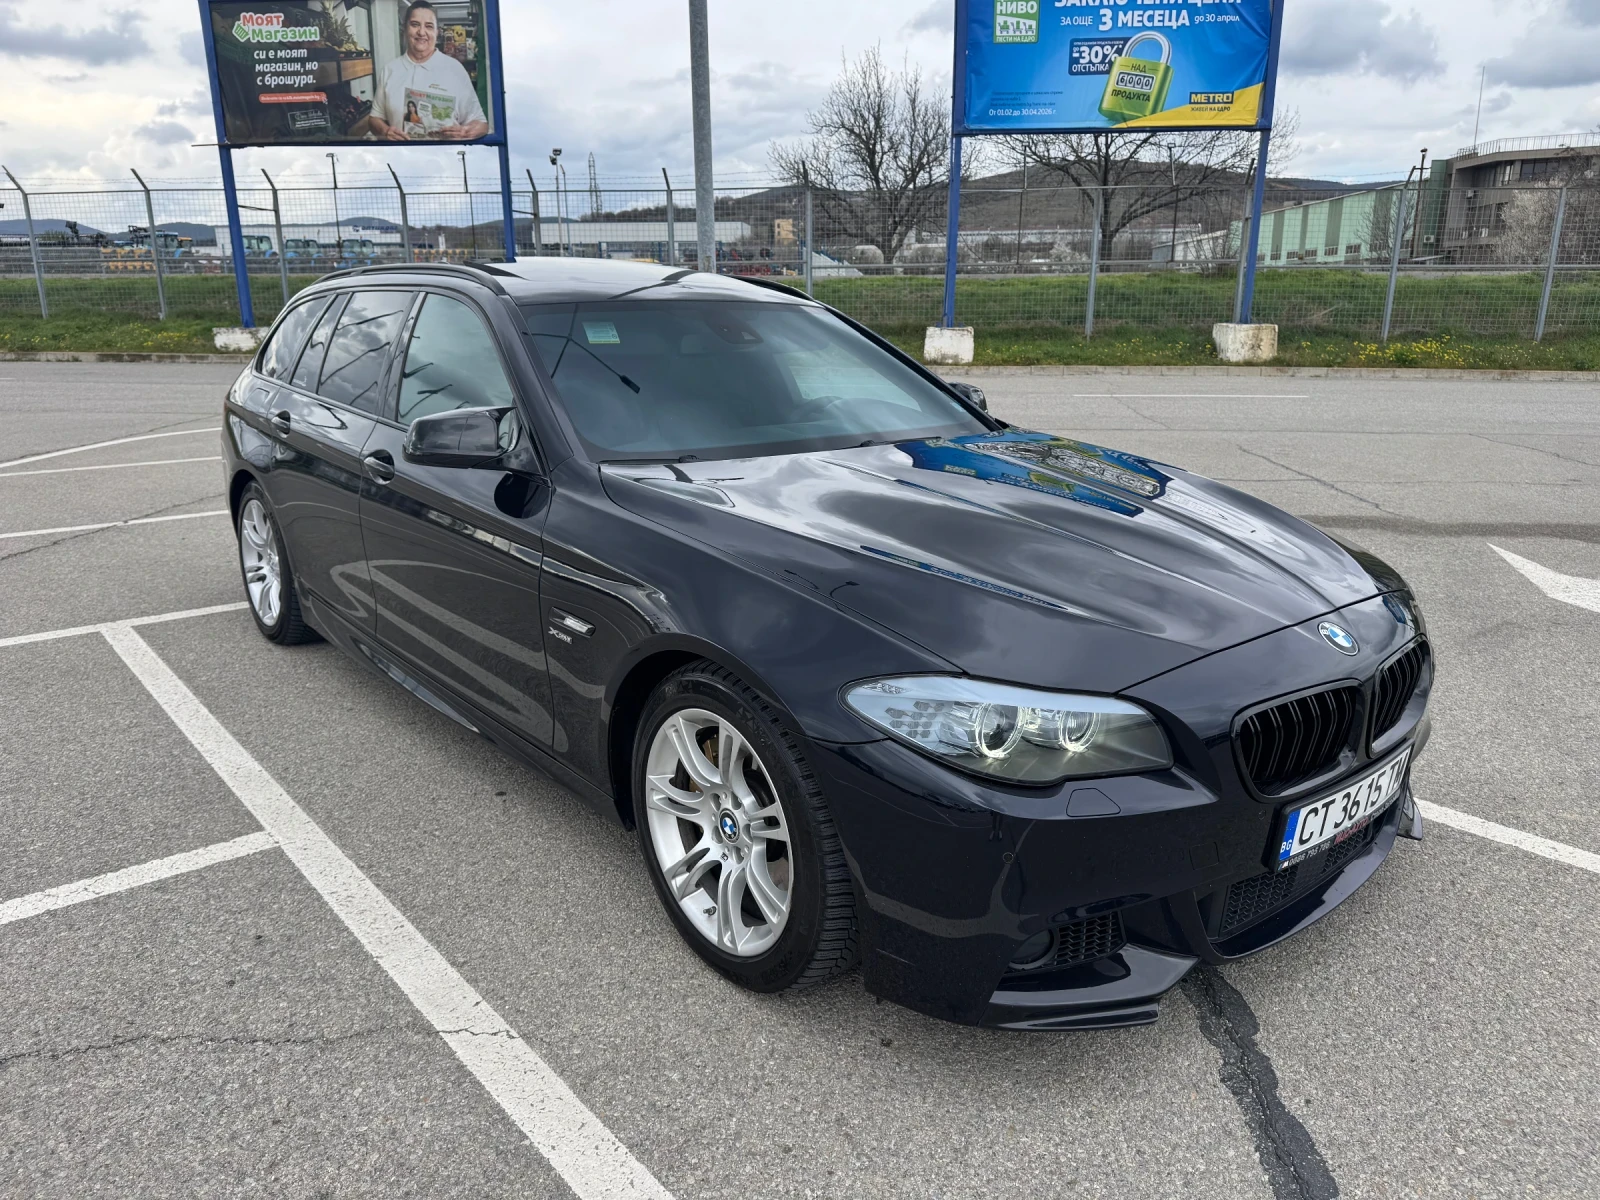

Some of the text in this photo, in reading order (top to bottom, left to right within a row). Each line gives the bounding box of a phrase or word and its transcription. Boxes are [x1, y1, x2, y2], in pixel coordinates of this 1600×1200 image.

[996, 1, 1038, 14] НИВО
[241, 14, 283, 27] Моят
[1060, 16, 1072, 26] ЗА
[1073, 16, 1094, 27] ОЩЕ
[1099, 8, 1112, 31] 3
[1117, 9, 1190, 29] МЕСЕЦА
[1205, 13, 1216, 22] 30
[1217, 14, 1240, 23] април
[251, 28, 318, 41] Магазин
[253, 48, 308, 59] си е моят
[255, 61, 318, 73] магазин, но
[1072, 63, 1110, 73] ОТСТЪПКА
[1130, 63, 1147, 73] НАД
[256, 73, 317, 88] с брошура.
[1119, 75, 1151, 88] 6000
[1111, 89, 1151, 103] ПРОДУКТА
[1191, 93, 1233, 103] METRO
[1299, 797, 1337, 845] CT
[1333, 769, 1387, 829] 3615
[1280, 839, 1292, 853] BG
